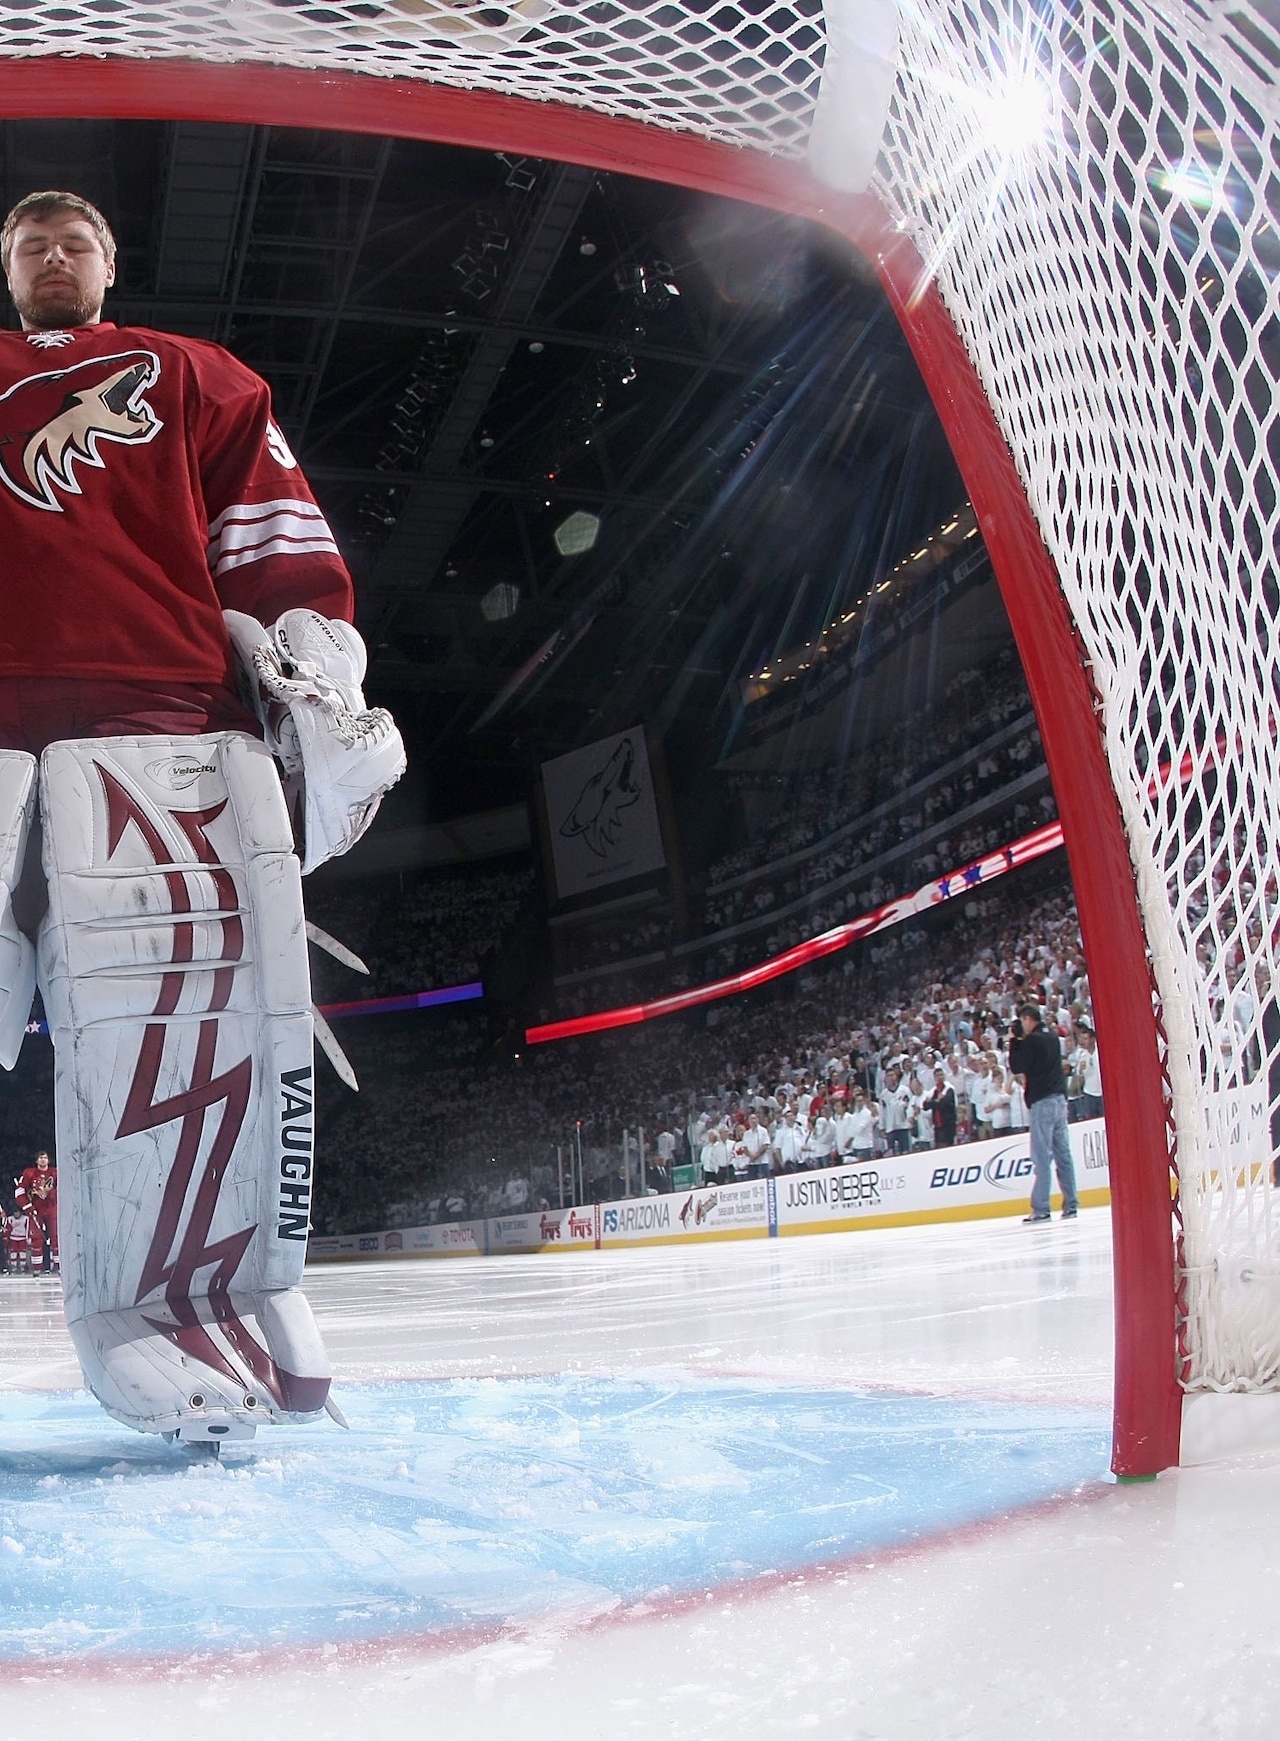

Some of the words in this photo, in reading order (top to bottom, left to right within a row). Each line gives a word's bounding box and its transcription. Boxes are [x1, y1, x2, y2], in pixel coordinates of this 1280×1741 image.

[172, 764, 217, 775] Velocity
[277, 1065, 312, 1241] VAUGHN
[930, 1166, 981, 1188] BUD
[994, 1157, 1034, 1180] LIG
[786, 1177, 827, 1208] JUSTIN
[830, 1171, 880, 1203] BIEBER
[603, 1209, 618, 1233] FS
[618, 1202, 670, 1231] ARIZONA
